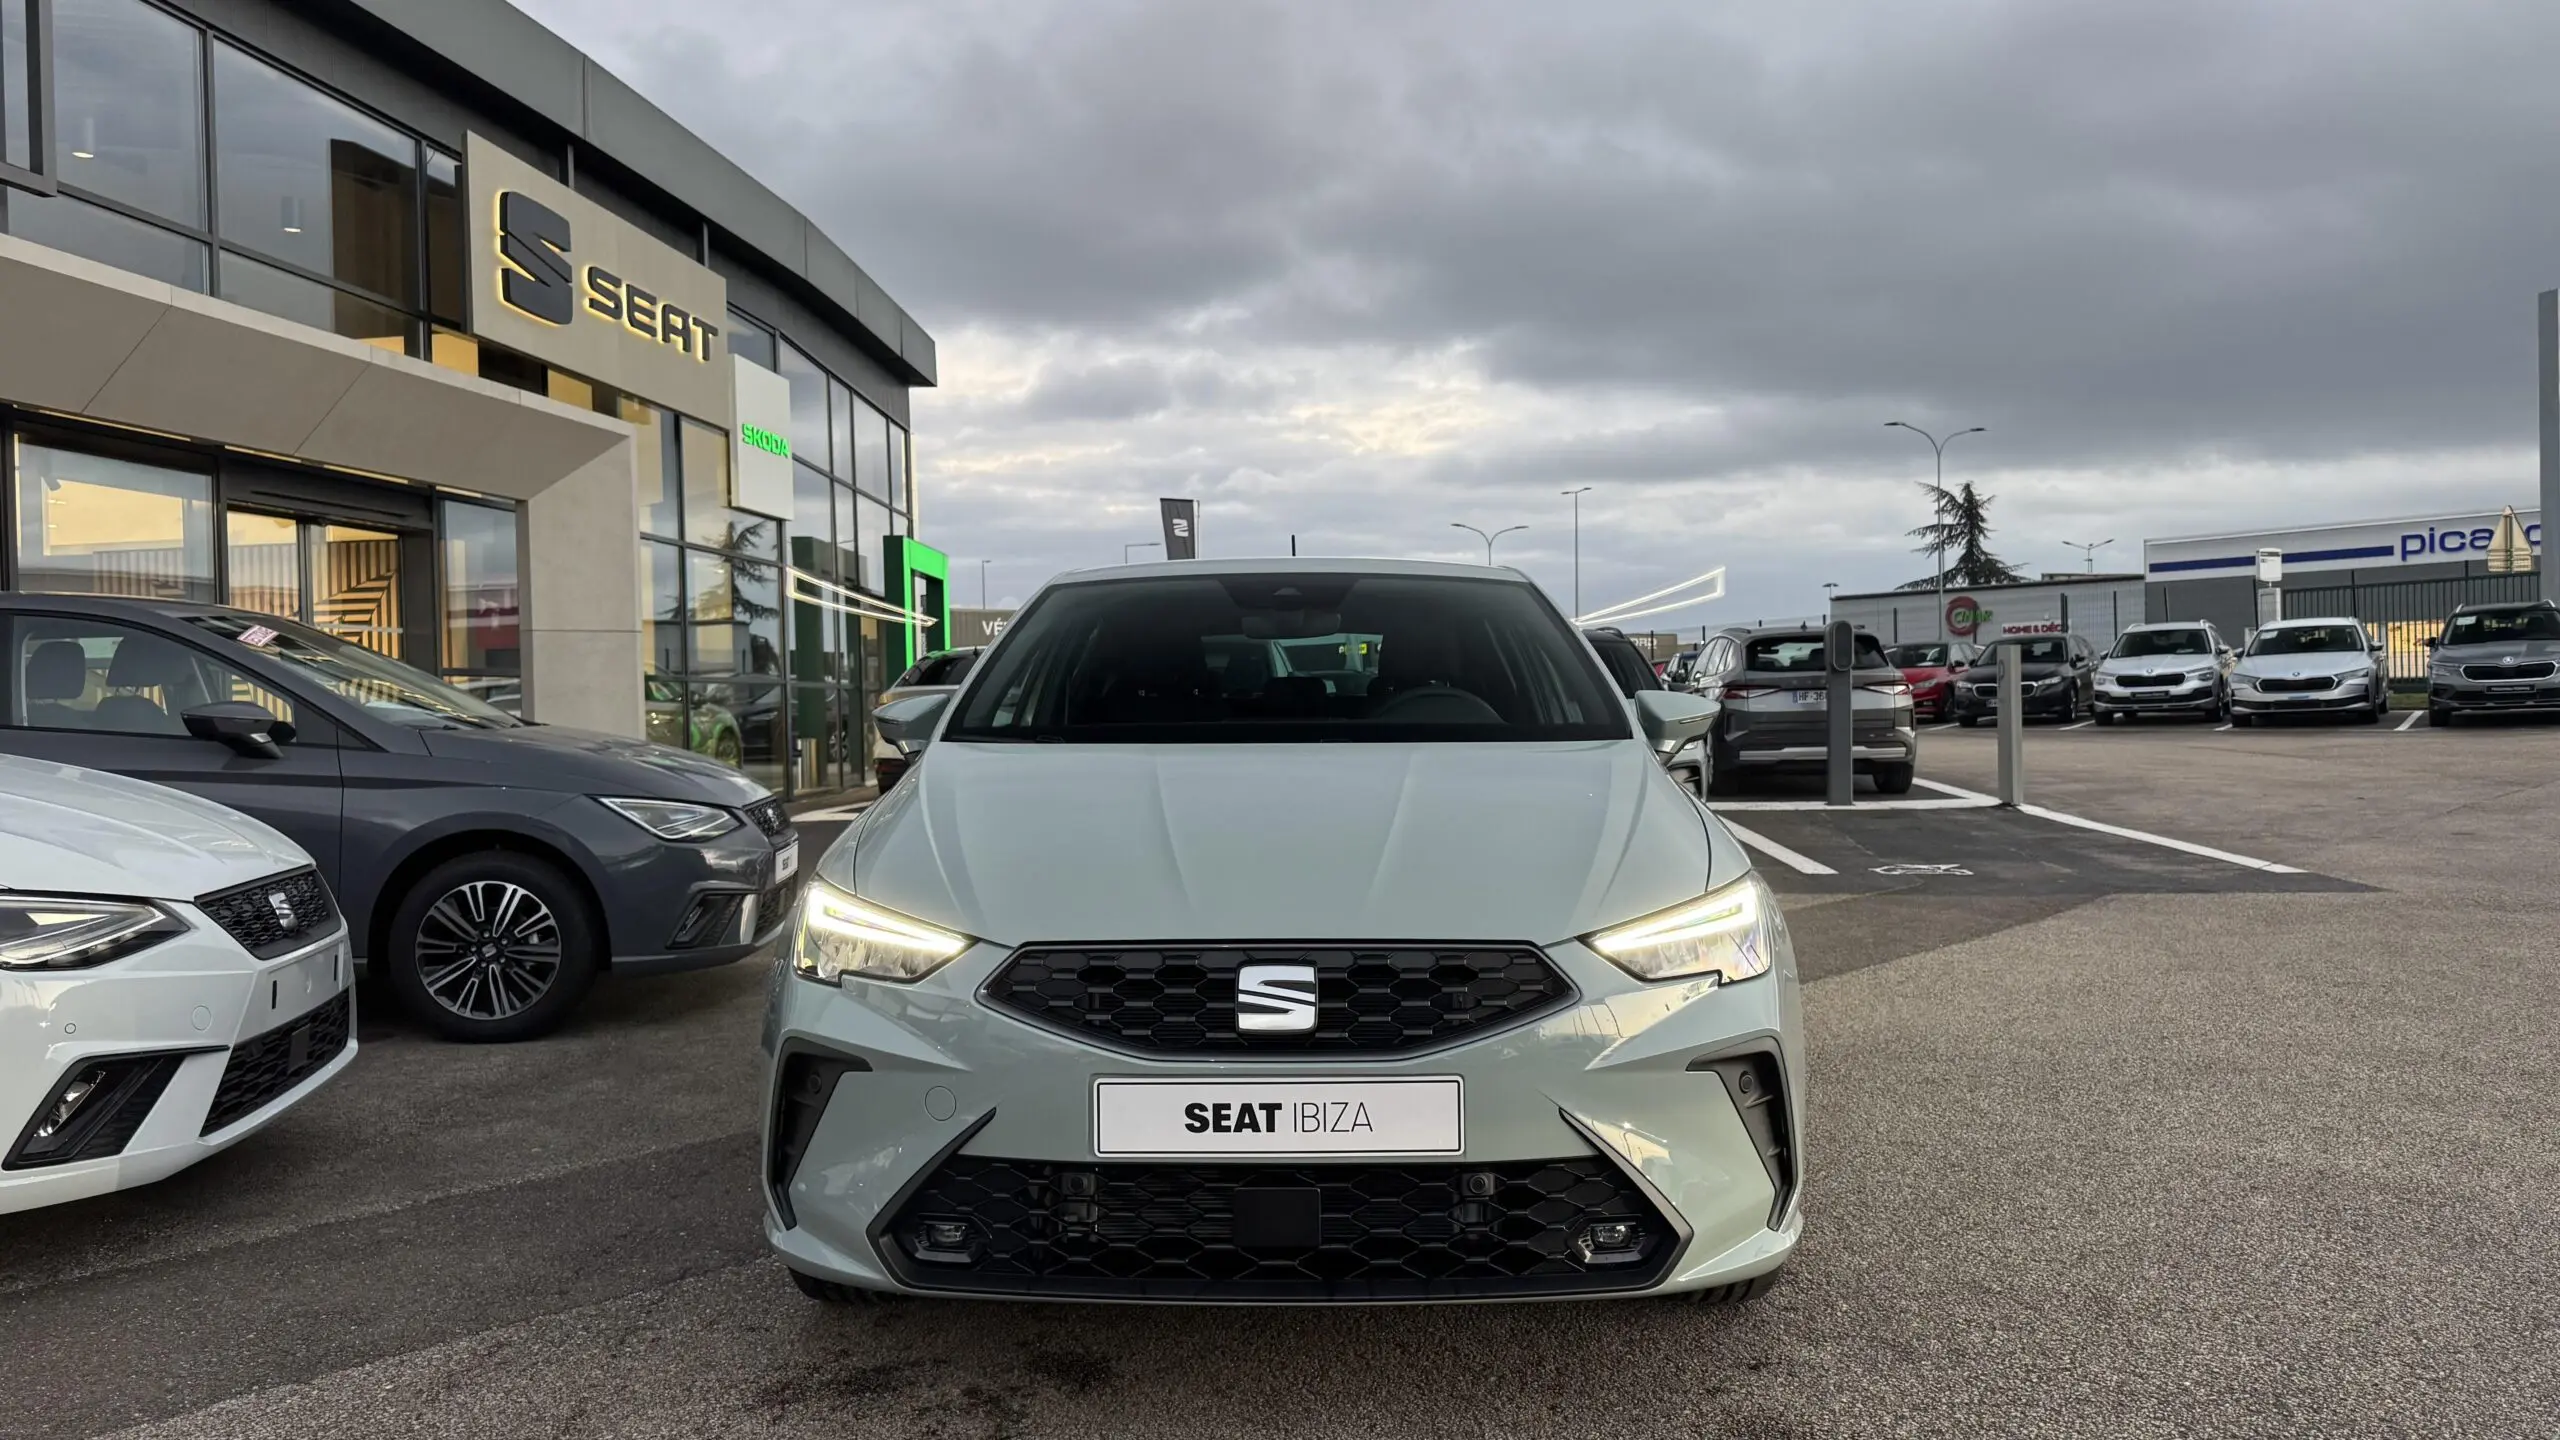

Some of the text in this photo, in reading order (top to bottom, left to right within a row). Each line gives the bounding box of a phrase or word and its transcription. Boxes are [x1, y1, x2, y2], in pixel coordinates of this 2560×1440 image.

[584, 265, 719, 362] SEAT
[982, 617, 1008, 636] VÉ
[1184, 1101, 1374, 1133] SEAT IBIZA
